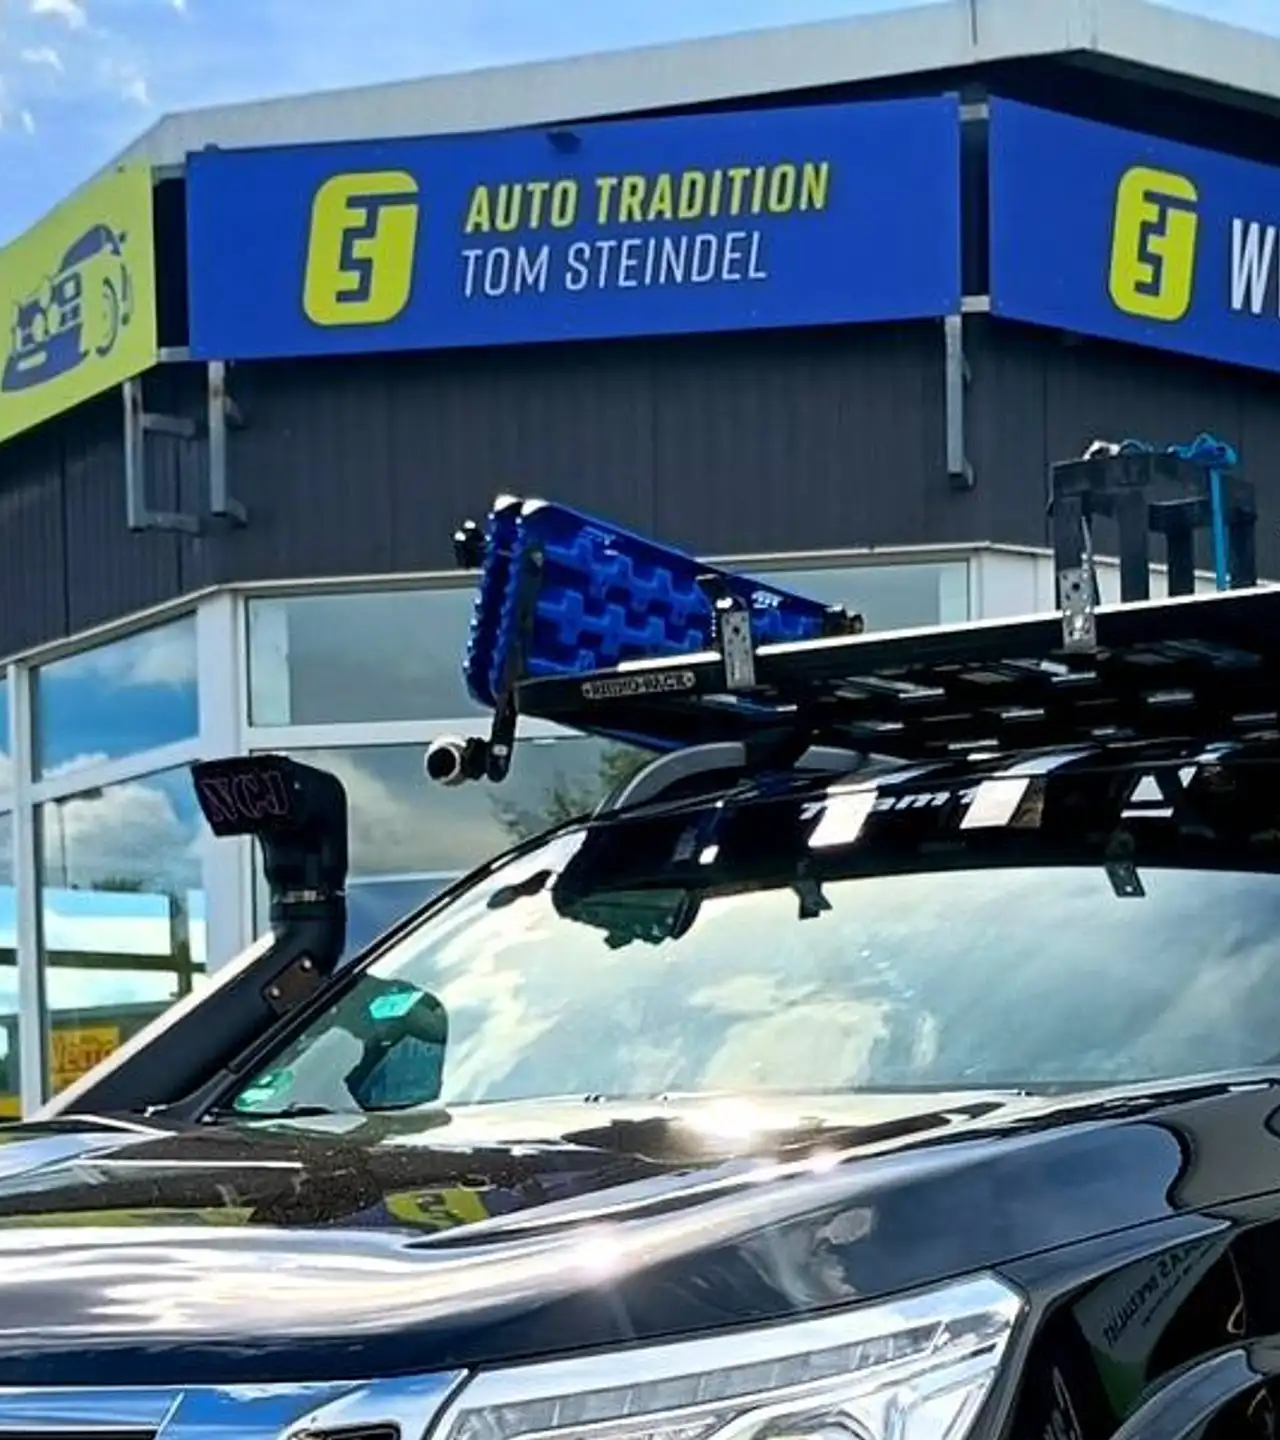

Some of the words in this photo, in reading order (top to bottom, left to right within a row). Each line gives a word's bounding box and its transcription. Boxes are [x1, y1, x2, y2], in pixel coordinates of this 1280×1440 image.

[464, 177, 575, 234] AUTO
[596, 160, 830, 225] TRADITION
[461, 245, 549, 298] TOM
[564, 230, 768, 291] STEINDEL
